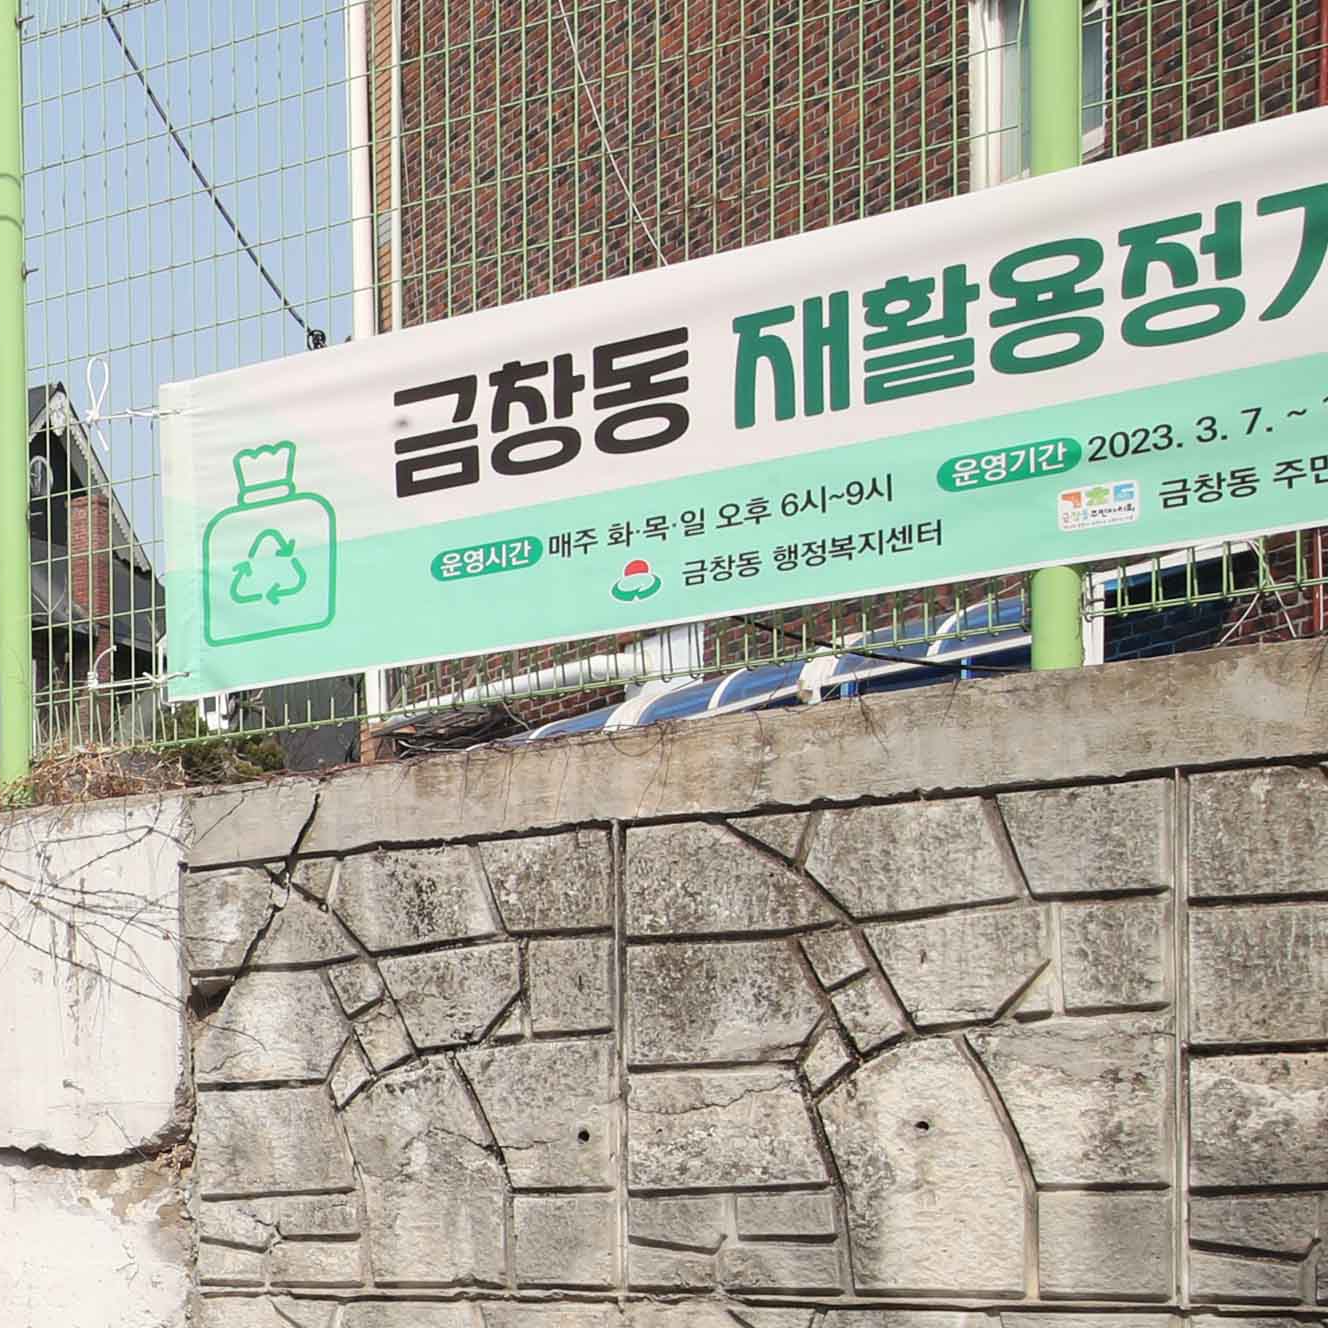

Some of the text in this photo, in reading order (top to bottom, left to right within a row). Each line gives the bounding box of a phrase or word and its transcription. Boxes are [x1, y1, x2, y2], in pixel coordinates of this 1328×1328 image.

[393, 326, 690, 499] 금창동
[951, 440, 1068, 487] 운영기간
[1087, 424, 1184, 462] 2023.
[1195, 416, 1228, 444] 3.
[1240, 407, 1273, 435] 7.
[439, 473, 895, 579] 운영시간 매주 화·목·일 오후 6시~9시
[1158, 465, 1261, 510] 금창동
[681, 518, 944, 586] 금창동 행정복지센터
